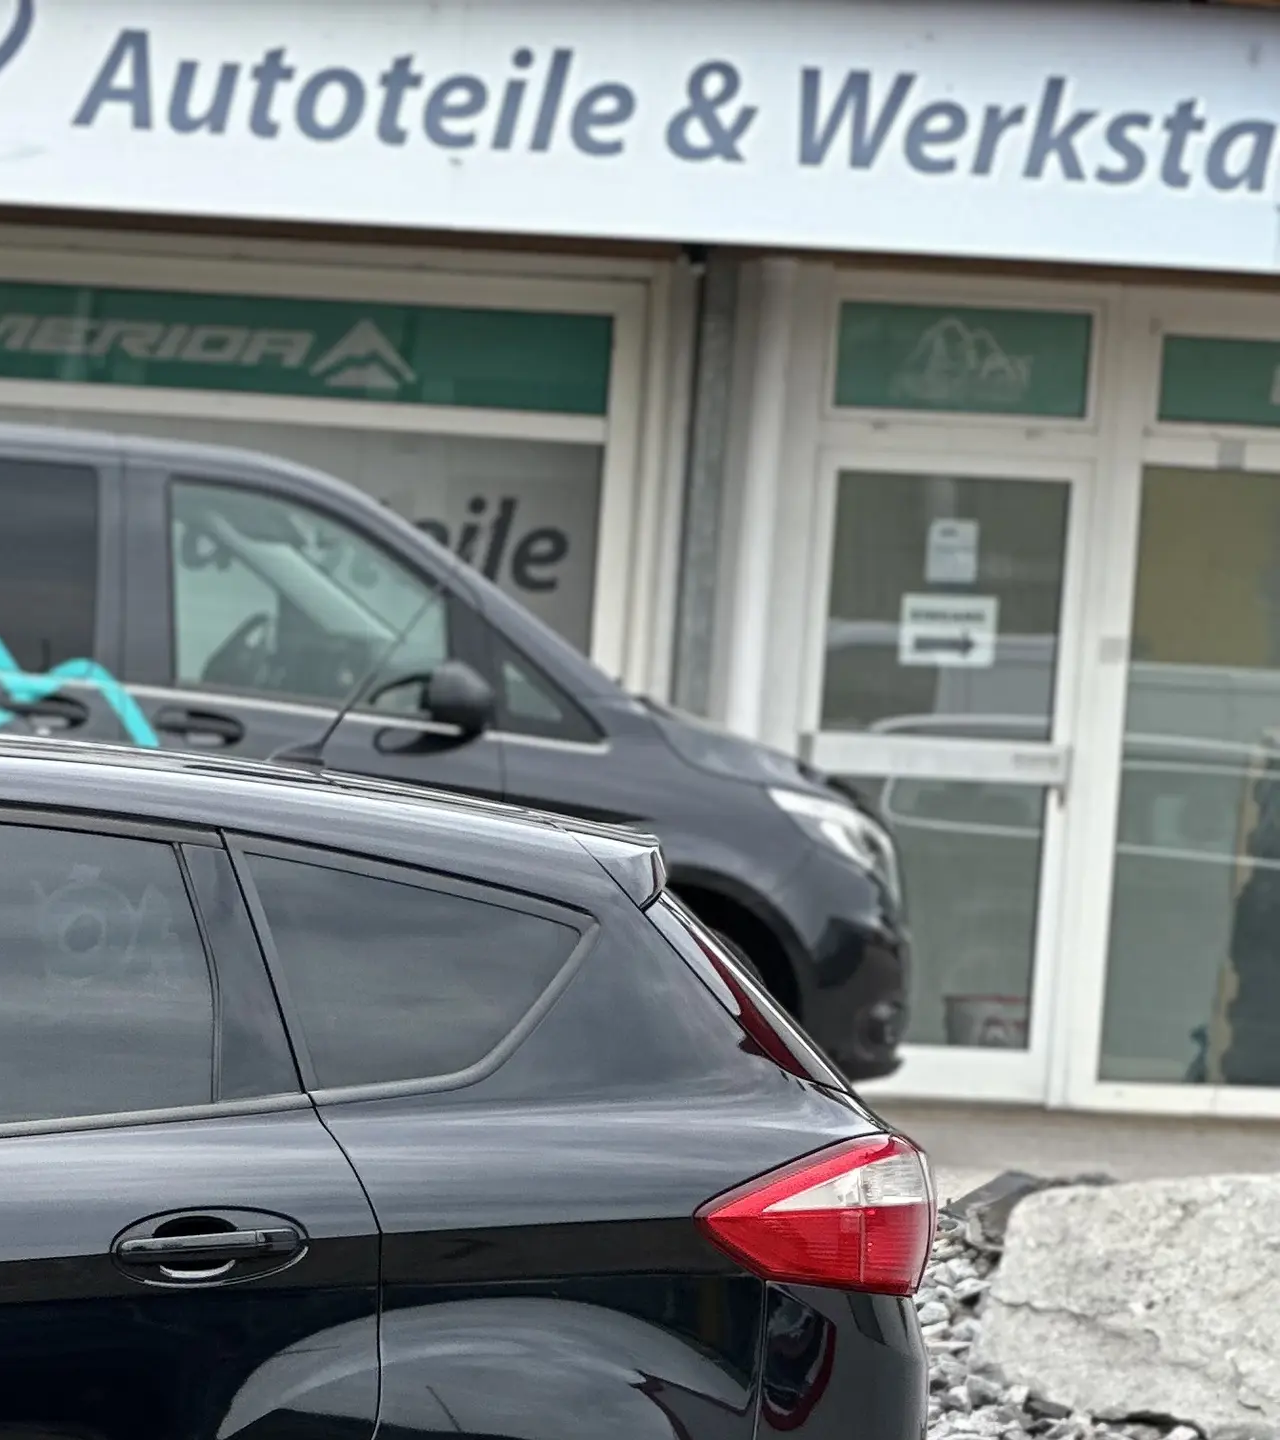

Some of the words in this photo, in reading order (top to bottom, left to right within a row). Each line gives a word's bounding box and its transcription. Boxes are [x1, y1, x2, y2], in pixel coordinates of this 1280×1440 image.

[72, 28, 635, 156] Autoteile
[666, 60, 757, 163] &
[798, 66, 1280, 193] Werksta
